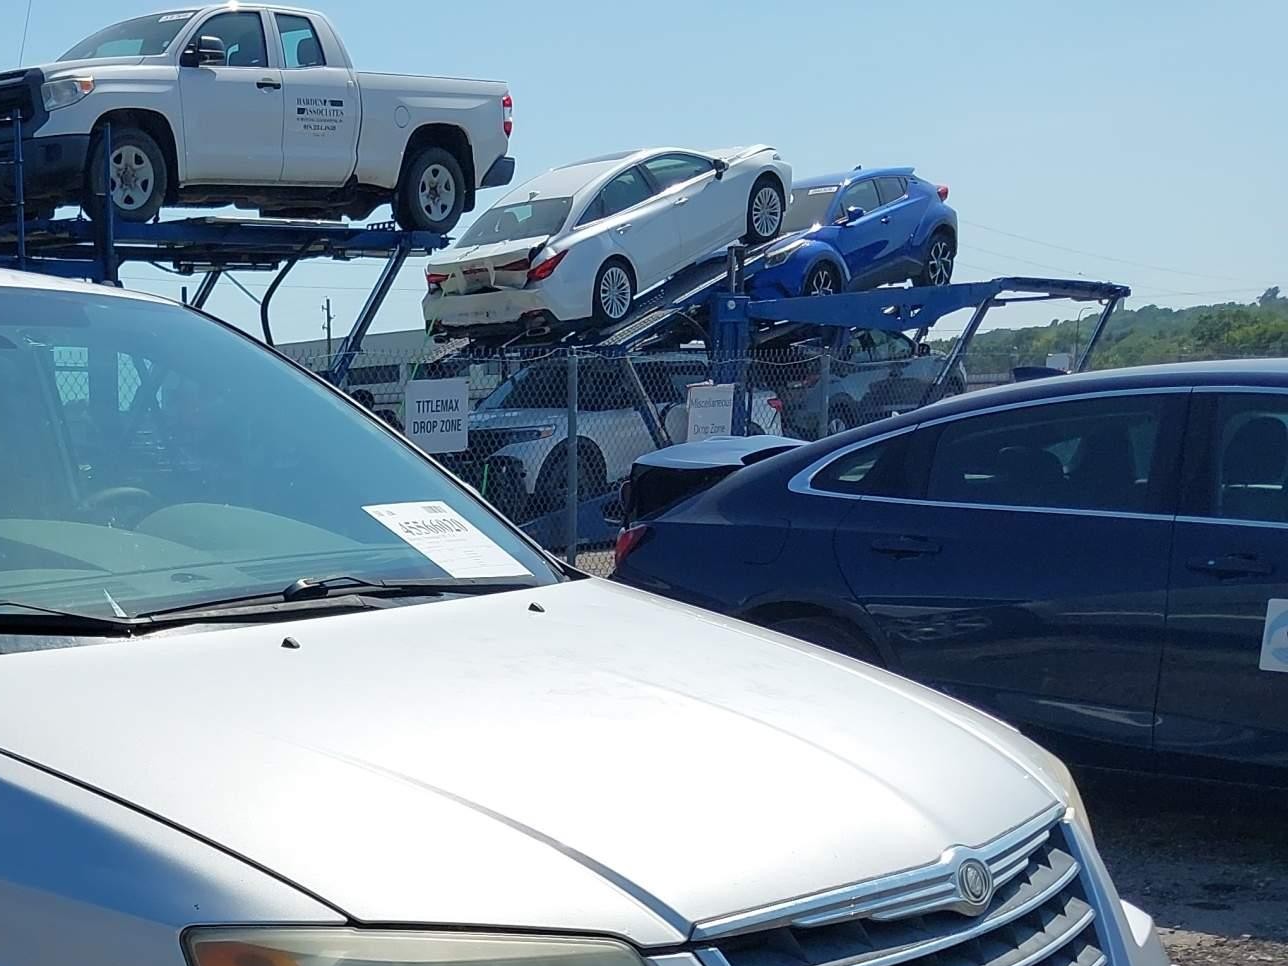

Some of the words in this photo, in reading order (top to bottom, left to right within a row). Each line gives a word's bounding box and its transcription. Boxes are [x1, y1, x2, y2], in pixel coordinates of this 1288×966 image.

[415, 399, 460, 414] TITLEMAX
[413, 420, 438, 434] DROP
[440, 419, 462, 433] ZONE
[710, 424, 726, 434] Zone
[398, 518, 469, 536] 45566020
